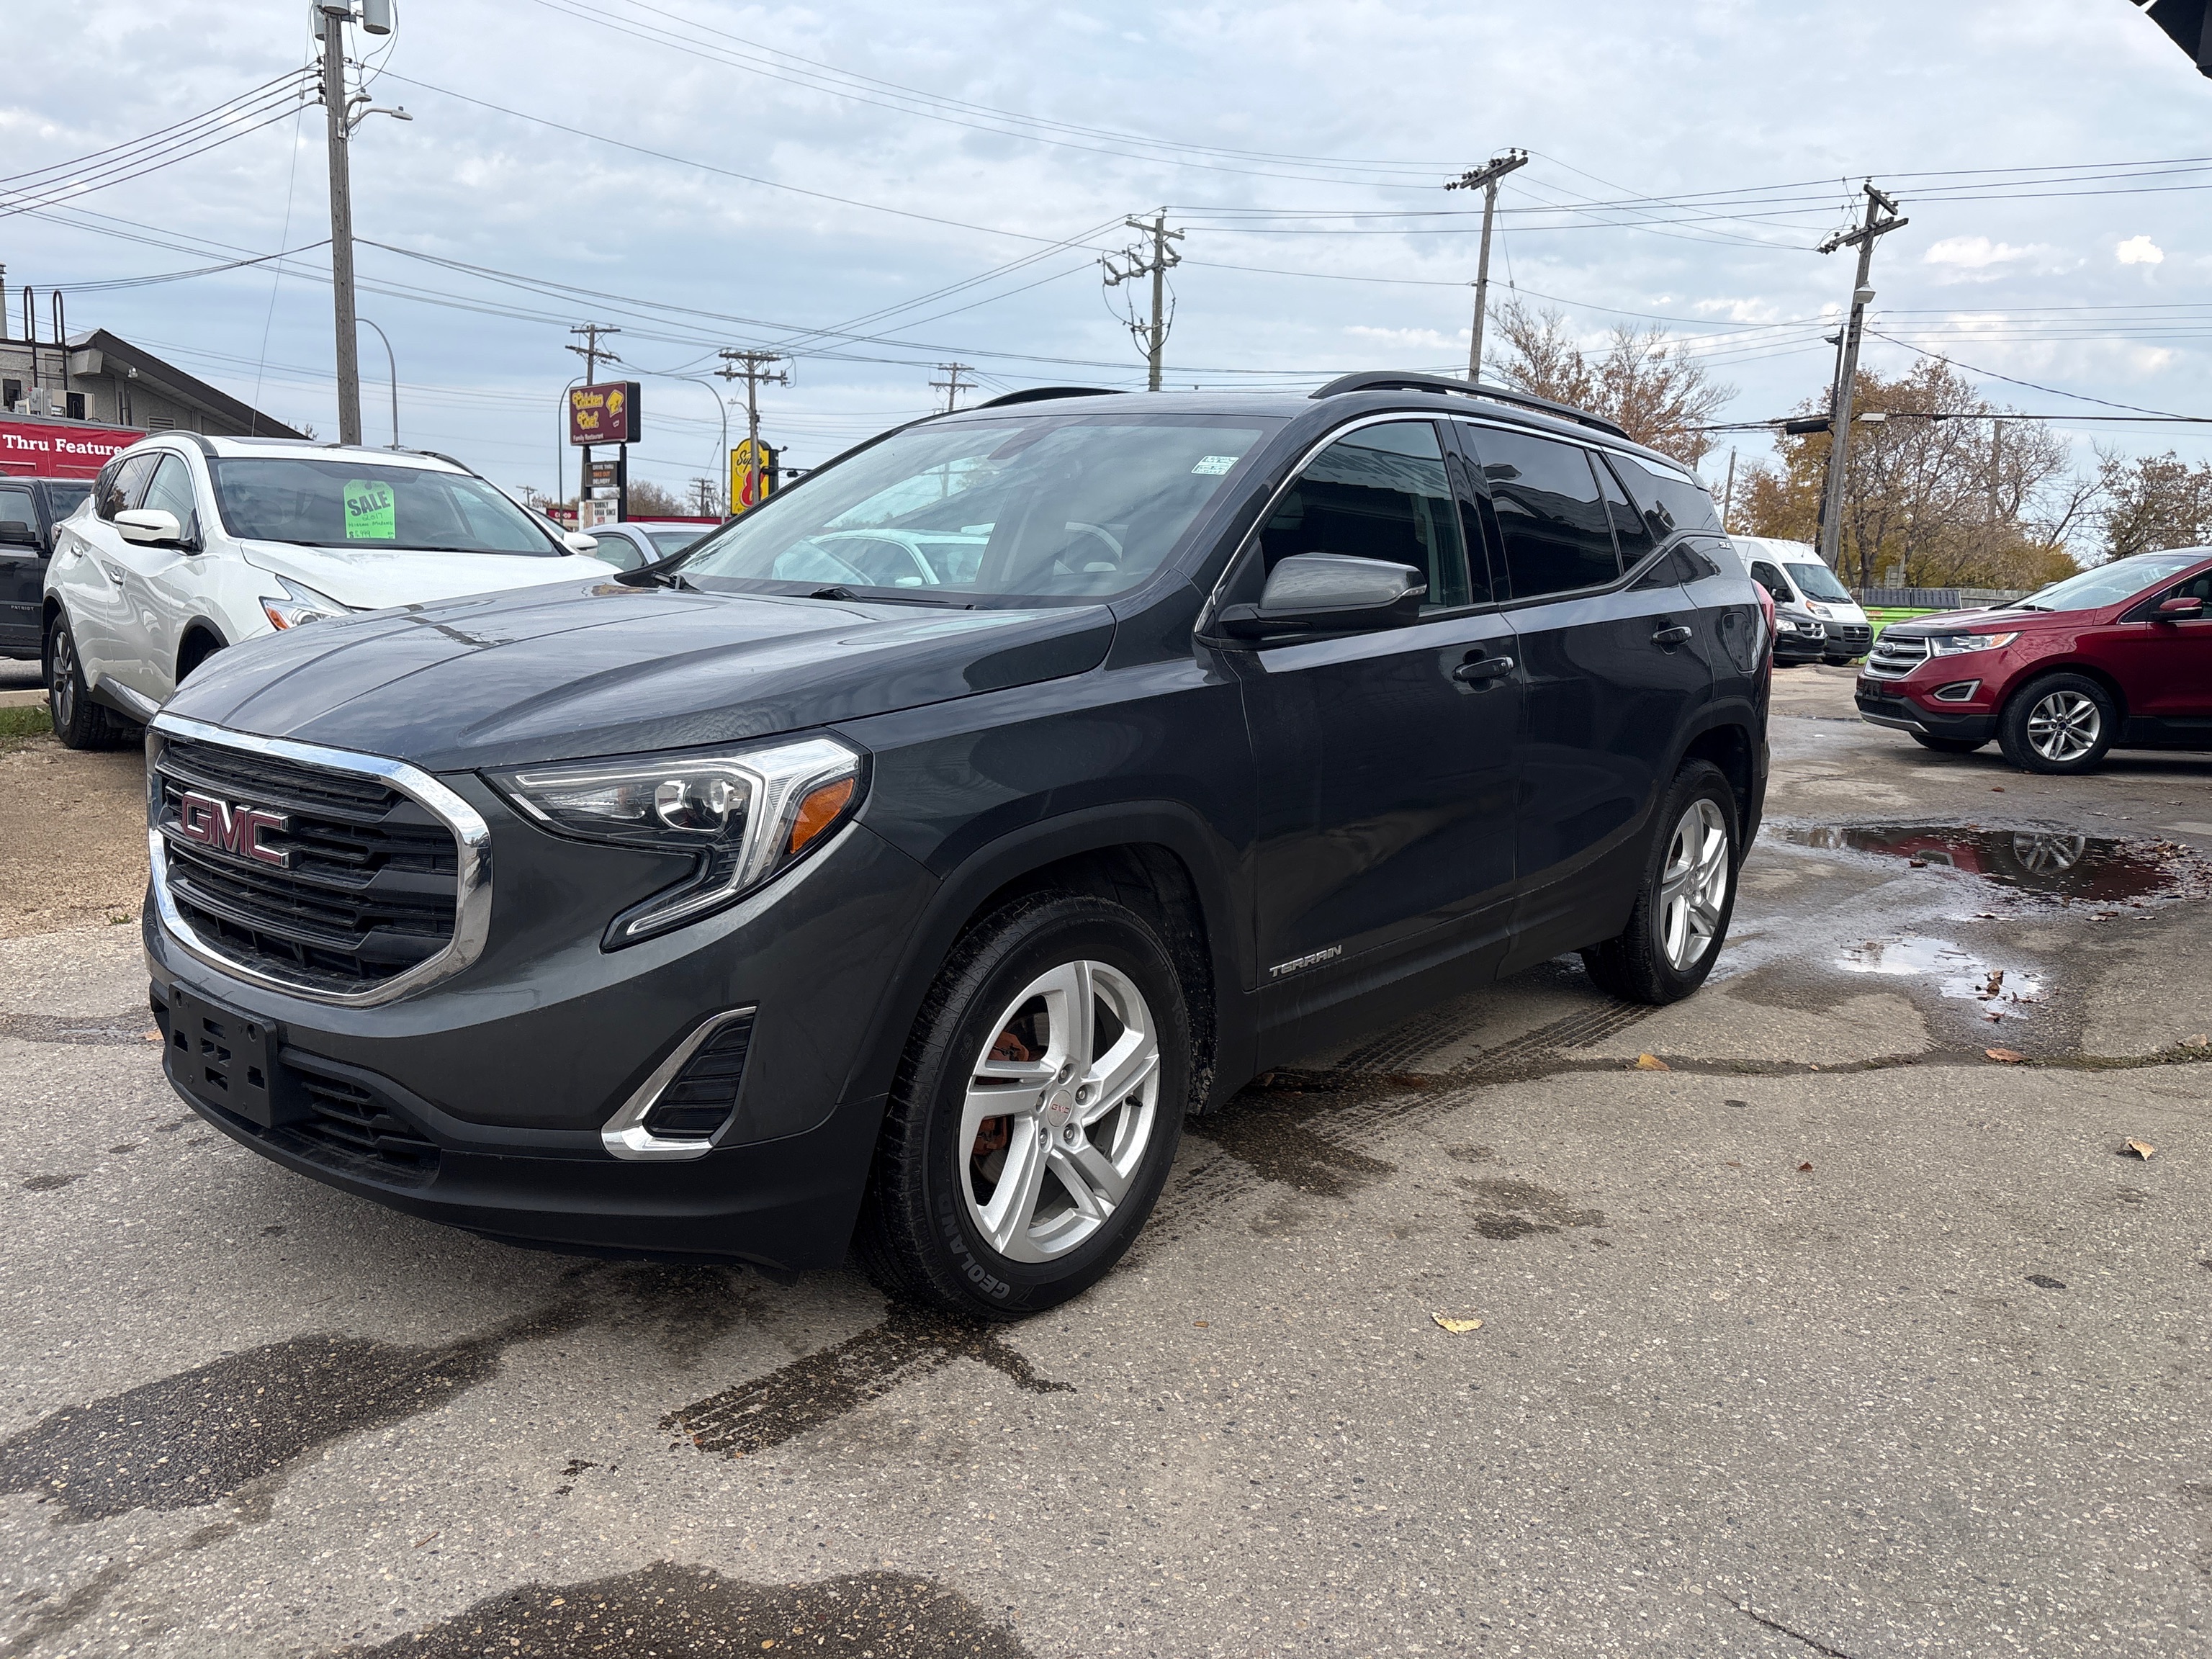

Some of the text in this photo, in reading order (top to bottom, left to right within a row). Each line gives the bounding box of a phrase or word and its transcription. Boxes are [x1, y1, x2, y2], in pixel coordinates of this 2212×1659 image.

[572, 391, 603, 410] Chicken
[577, 411, 599, 430] Chef
[3, 434, 50, 452] Thru
[737, 449, 764, 473] Supr
[347, 490, 391, 517] SALE
[182, 791, 289, 868] GMC
[1269, 944, 1342, 978] TERRAIN
[1051, 1103, 1070, 1114] GMC
